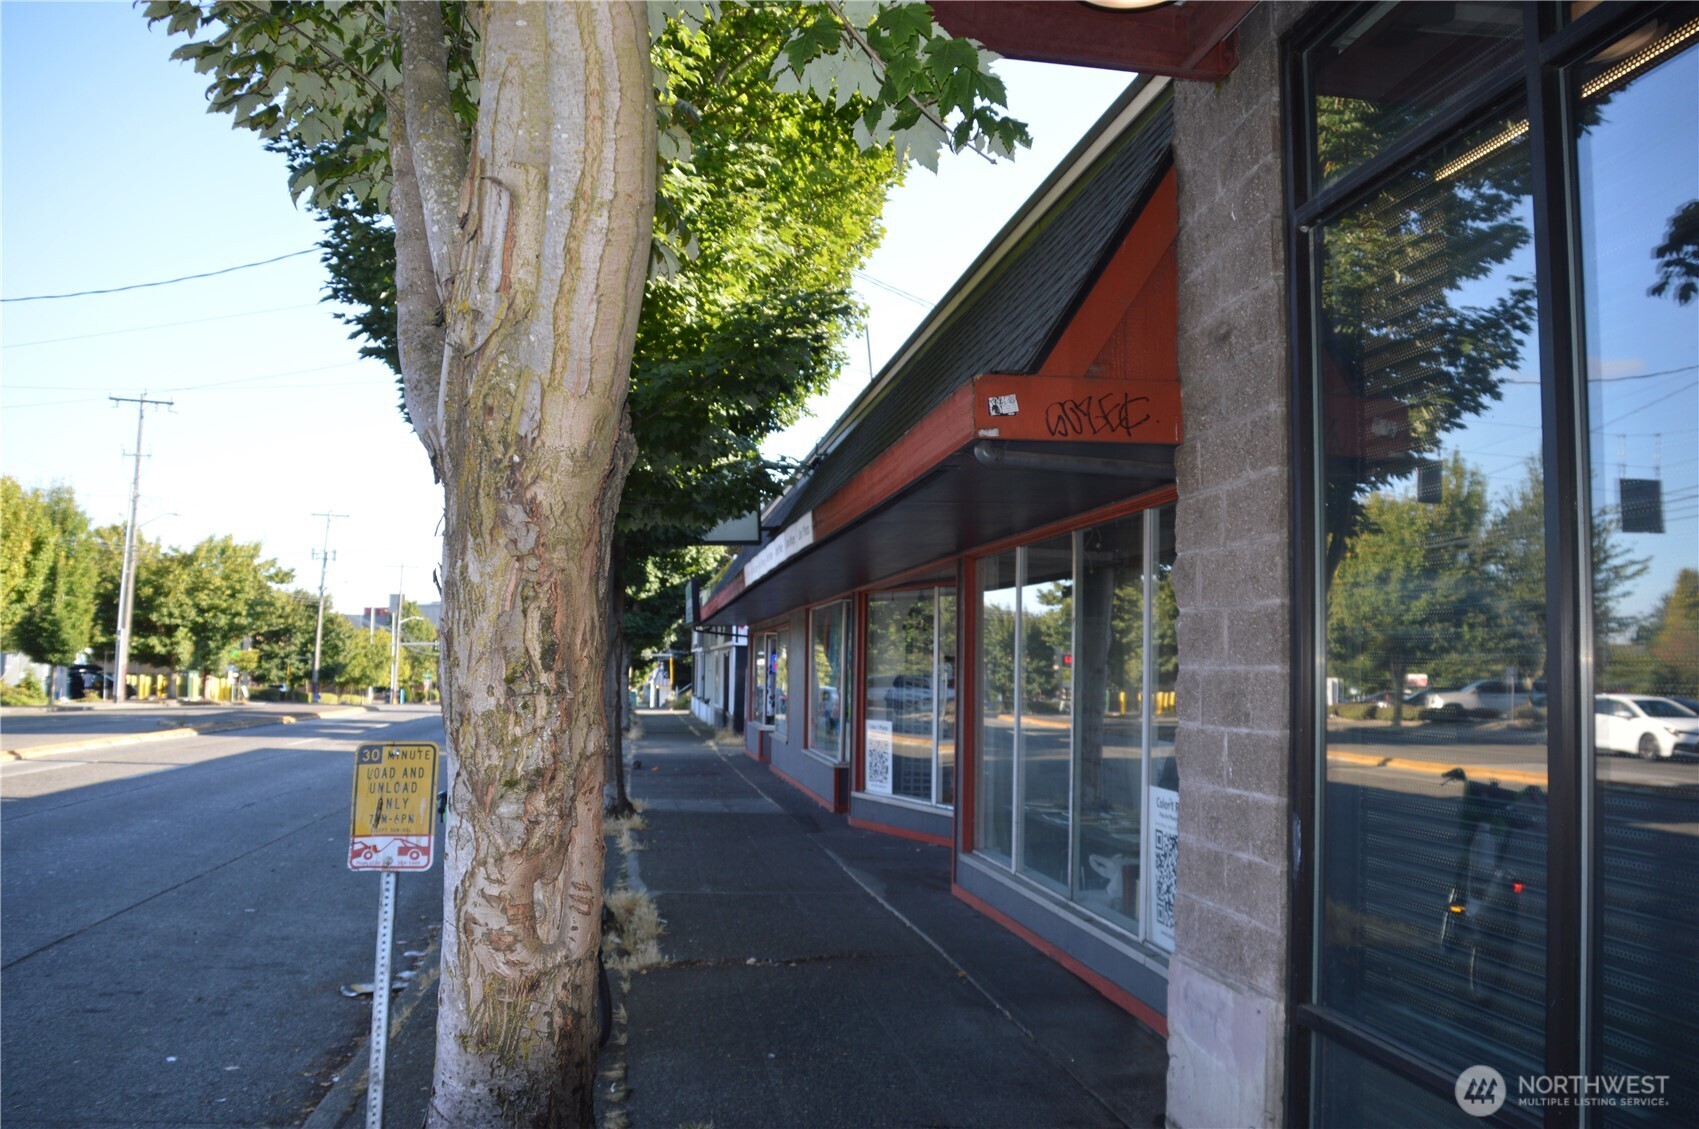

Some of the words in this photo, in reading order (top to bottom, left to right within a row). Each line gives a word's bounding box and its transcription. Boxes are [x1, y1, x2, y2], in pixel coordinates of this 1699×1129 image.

[362, 749, 380, 762] 30
[367, 767, 396, 779] LOAD
[402, 767, 424, 779] AND
[370, 782, 417, 794] UNLOAD
[378, 798, 409, 810] NLY
[369, 814, 415, 825] 7M-6PM
